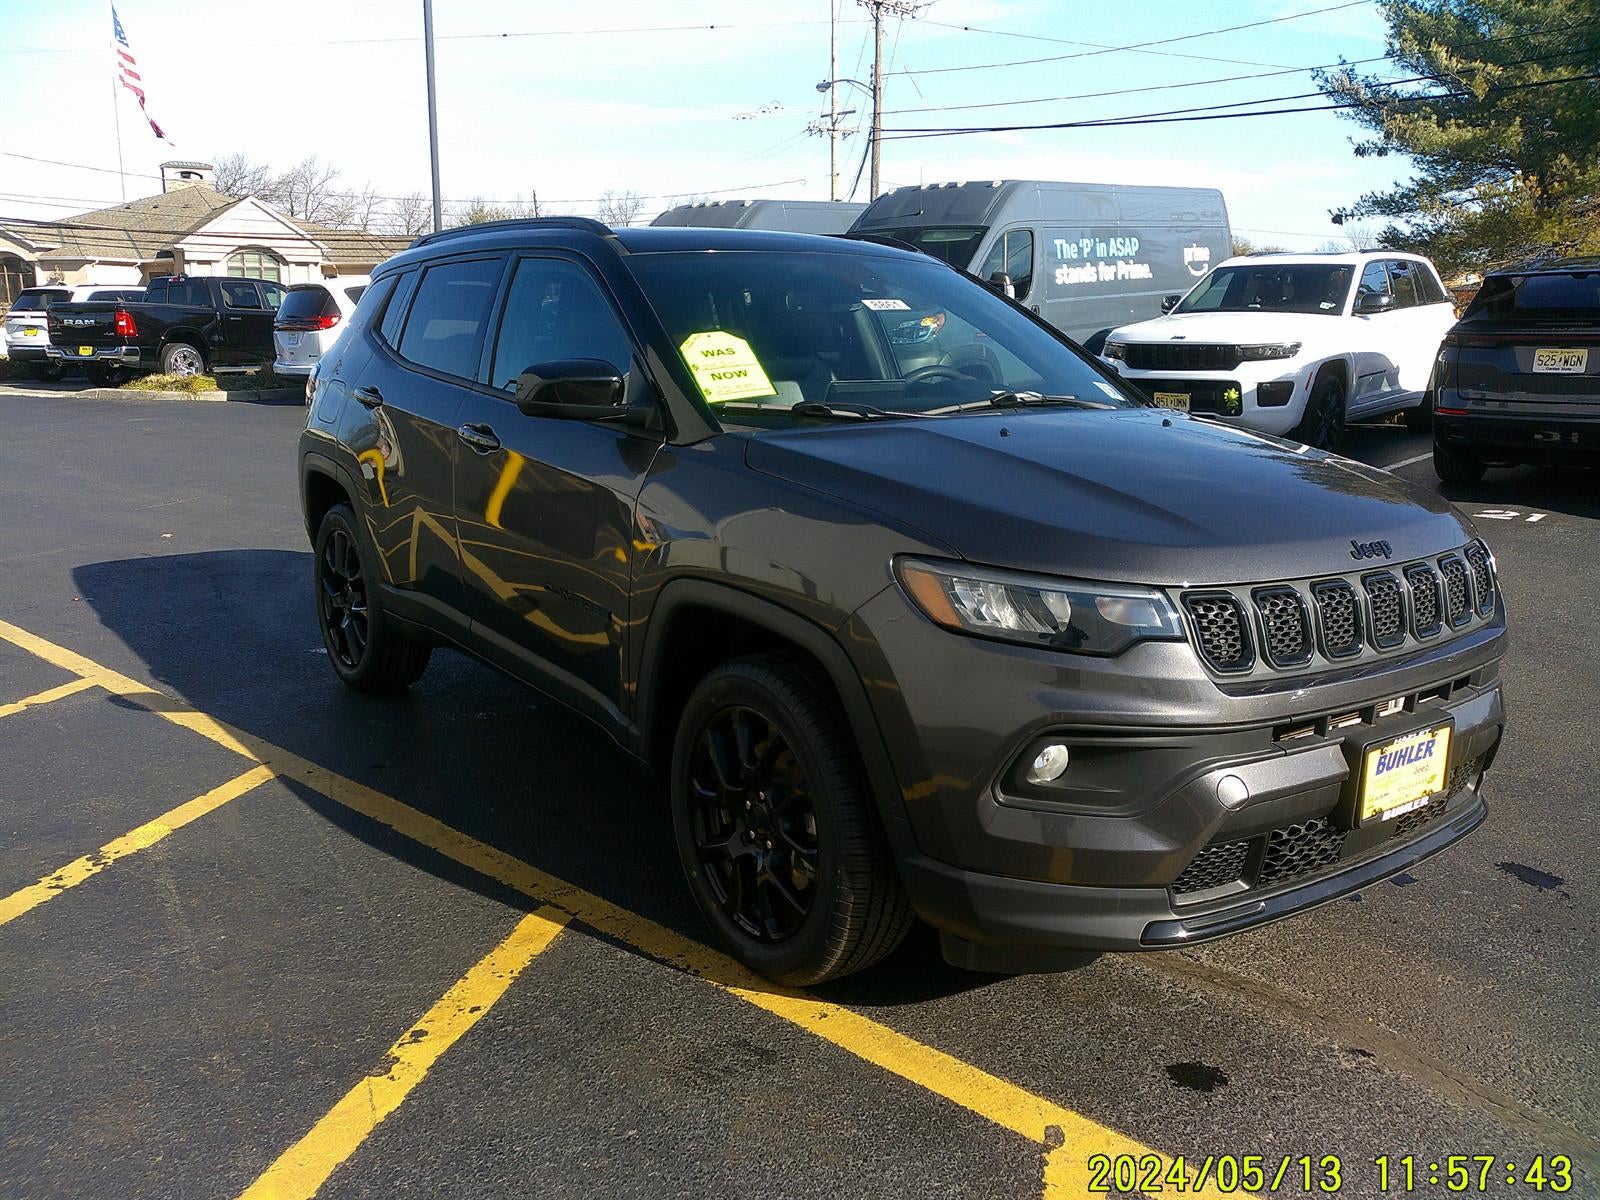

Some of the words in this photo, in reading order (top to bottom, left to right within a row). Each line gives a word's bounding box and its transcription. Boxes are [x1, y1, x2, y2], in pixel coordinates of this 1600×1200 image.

[1054, 239, 1078, 259] The
[1096, 238, 1107, 257] in
[1109, 237, 1139, 257] ASAP
[1184, 243, 1210, 265] prime
[1055, 262, 1097, 285] stands
[1098, 261, 1116, 281] for
[1117, 260, 1153, 280] Prime.
[700, 348, 736, 357] WAS
[1563, 355, 1584, 367] WGN
[711, 370, 748, 380] NOW
[1472, 509, 1548, 522] 21
[1350, 539, 1393, 561] Jeep
[1375, 738, 1437, 776] BUHLER
[1381, 796, 1430, 821] BUHLER
